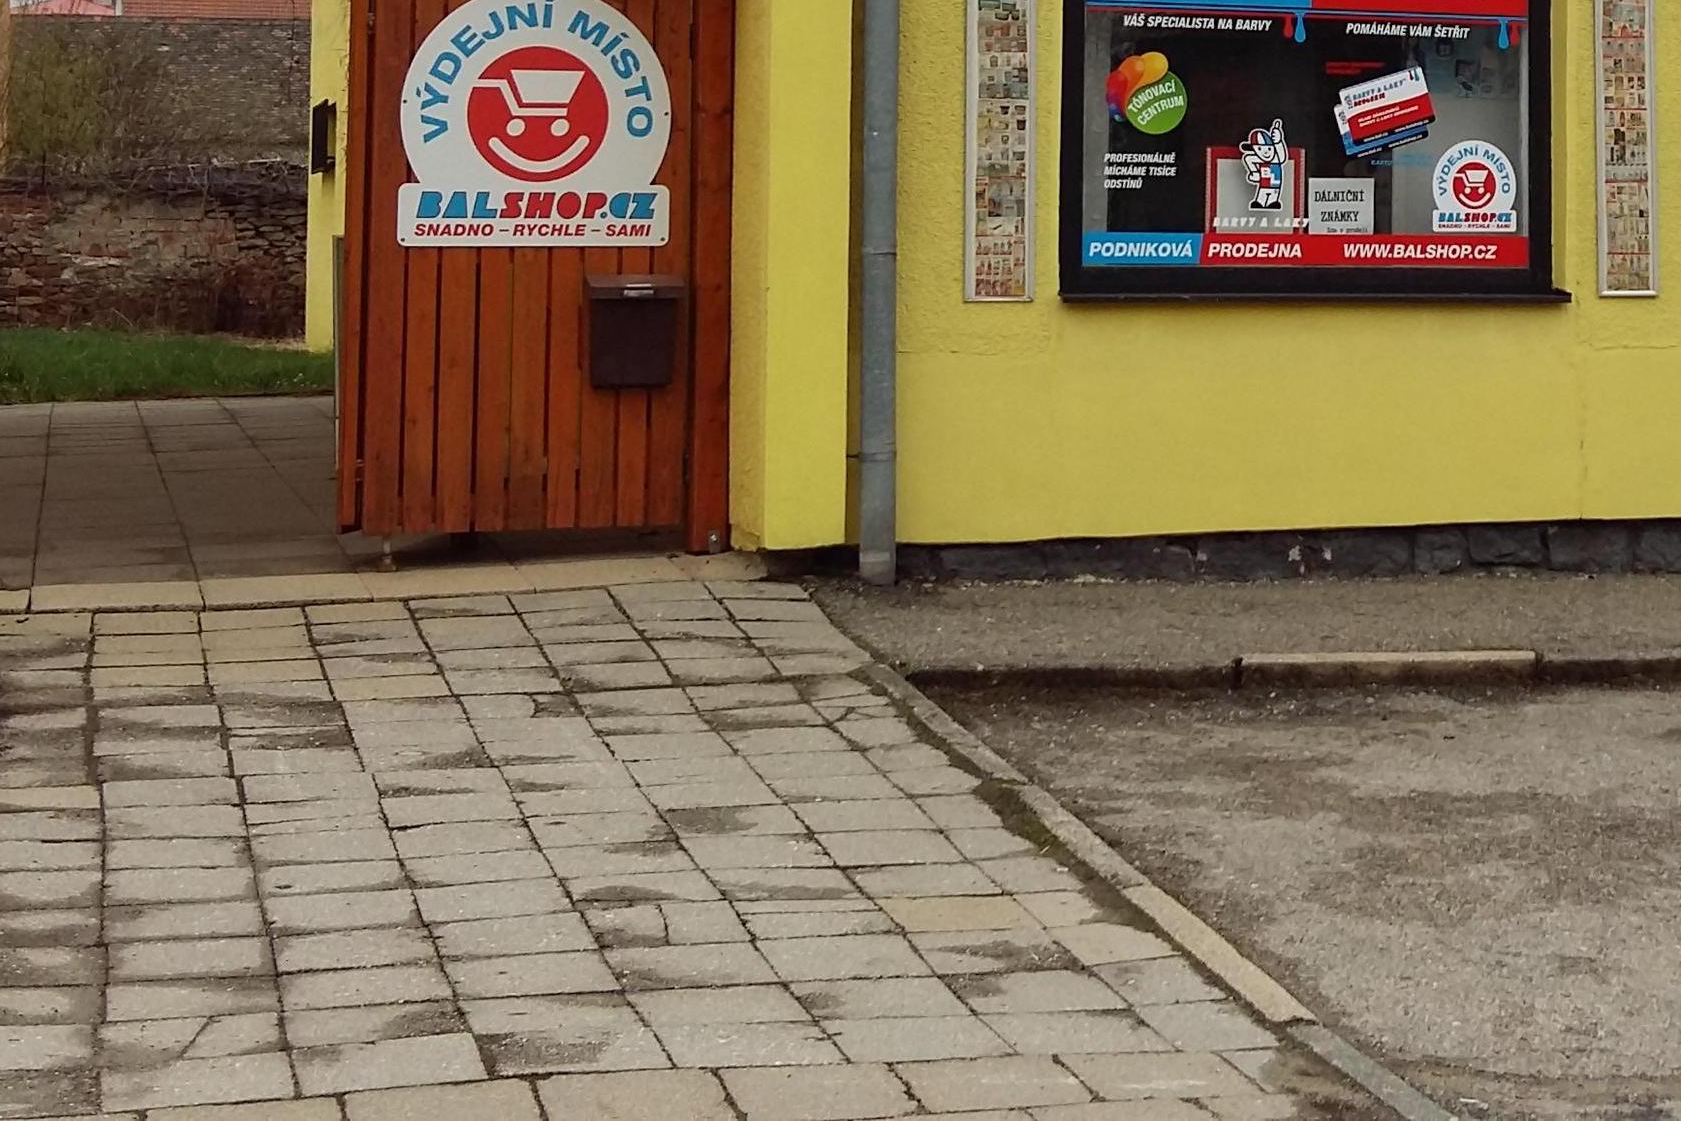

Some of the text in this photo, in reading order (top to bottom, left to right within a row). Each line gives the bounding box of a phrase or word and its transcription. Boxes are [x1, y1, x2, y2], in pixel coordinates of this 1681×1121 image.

[1123, 14, 1272, 31] VÁŠ SPECIALISTA NA BARVY
[1346, 22, 1470, 39] POMÁHÁME VÁM ŠETŘIT
[567, 10, 654, 139] MÍSTO
[1127, 79, 1185, 126] TÓNOVACÍ CENTRUM
[1103, 152, 1176, 164] PROFESIONÁLNĚ
[1103, 164, 1177, 176] MÍCHÁME TISÍCE
[1103, 177, 1143, 189] ODSTÍNŮ
[1314, 189, 1364, 202] DÁLNIČNÍ
[416, 191, 658, 220] BALSHOP.CZ
[1321, 209, 1359, 222] ZNÁMKY
[414, 223, 651, 237] SNADNO RYCHLE SAMI
[1089, 239, 1302, 258] PODNIKOVÁ PRODEJNA
[1343, 243, 1497, 259] WWW.BALSHOP.CZ
